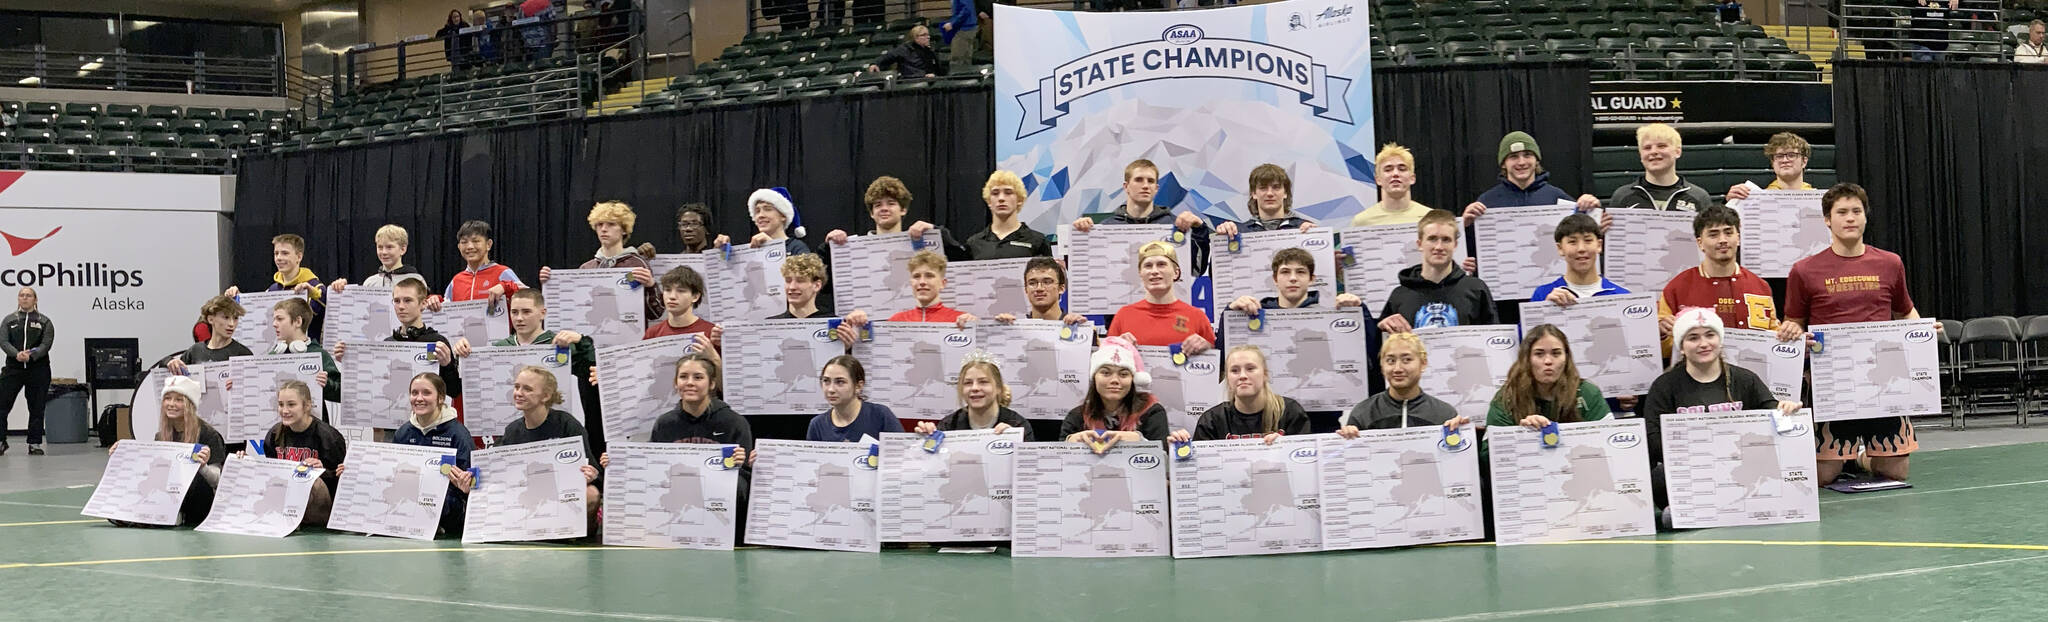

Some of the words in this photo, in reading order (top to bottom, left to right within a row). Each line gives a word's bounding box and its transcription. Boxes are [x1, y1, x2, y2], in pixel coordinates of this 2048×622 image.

[1170, 30, 1196, 38] ASAA
[1059, 53, 1136, 96] STATE
[1143, 47, 1308, 85] CHAMPIONS
[1610, 96, 1666, 110] GUARD
[0, 262, 144, 292] coPhillips
[1839, 275, 1880, 284] EDGECUMBE
[1826, 282, 1880, 293] WRESTLING
[92, 296, 144, 310] Alaska
[1612, 434, 1636, 442] ASAA
